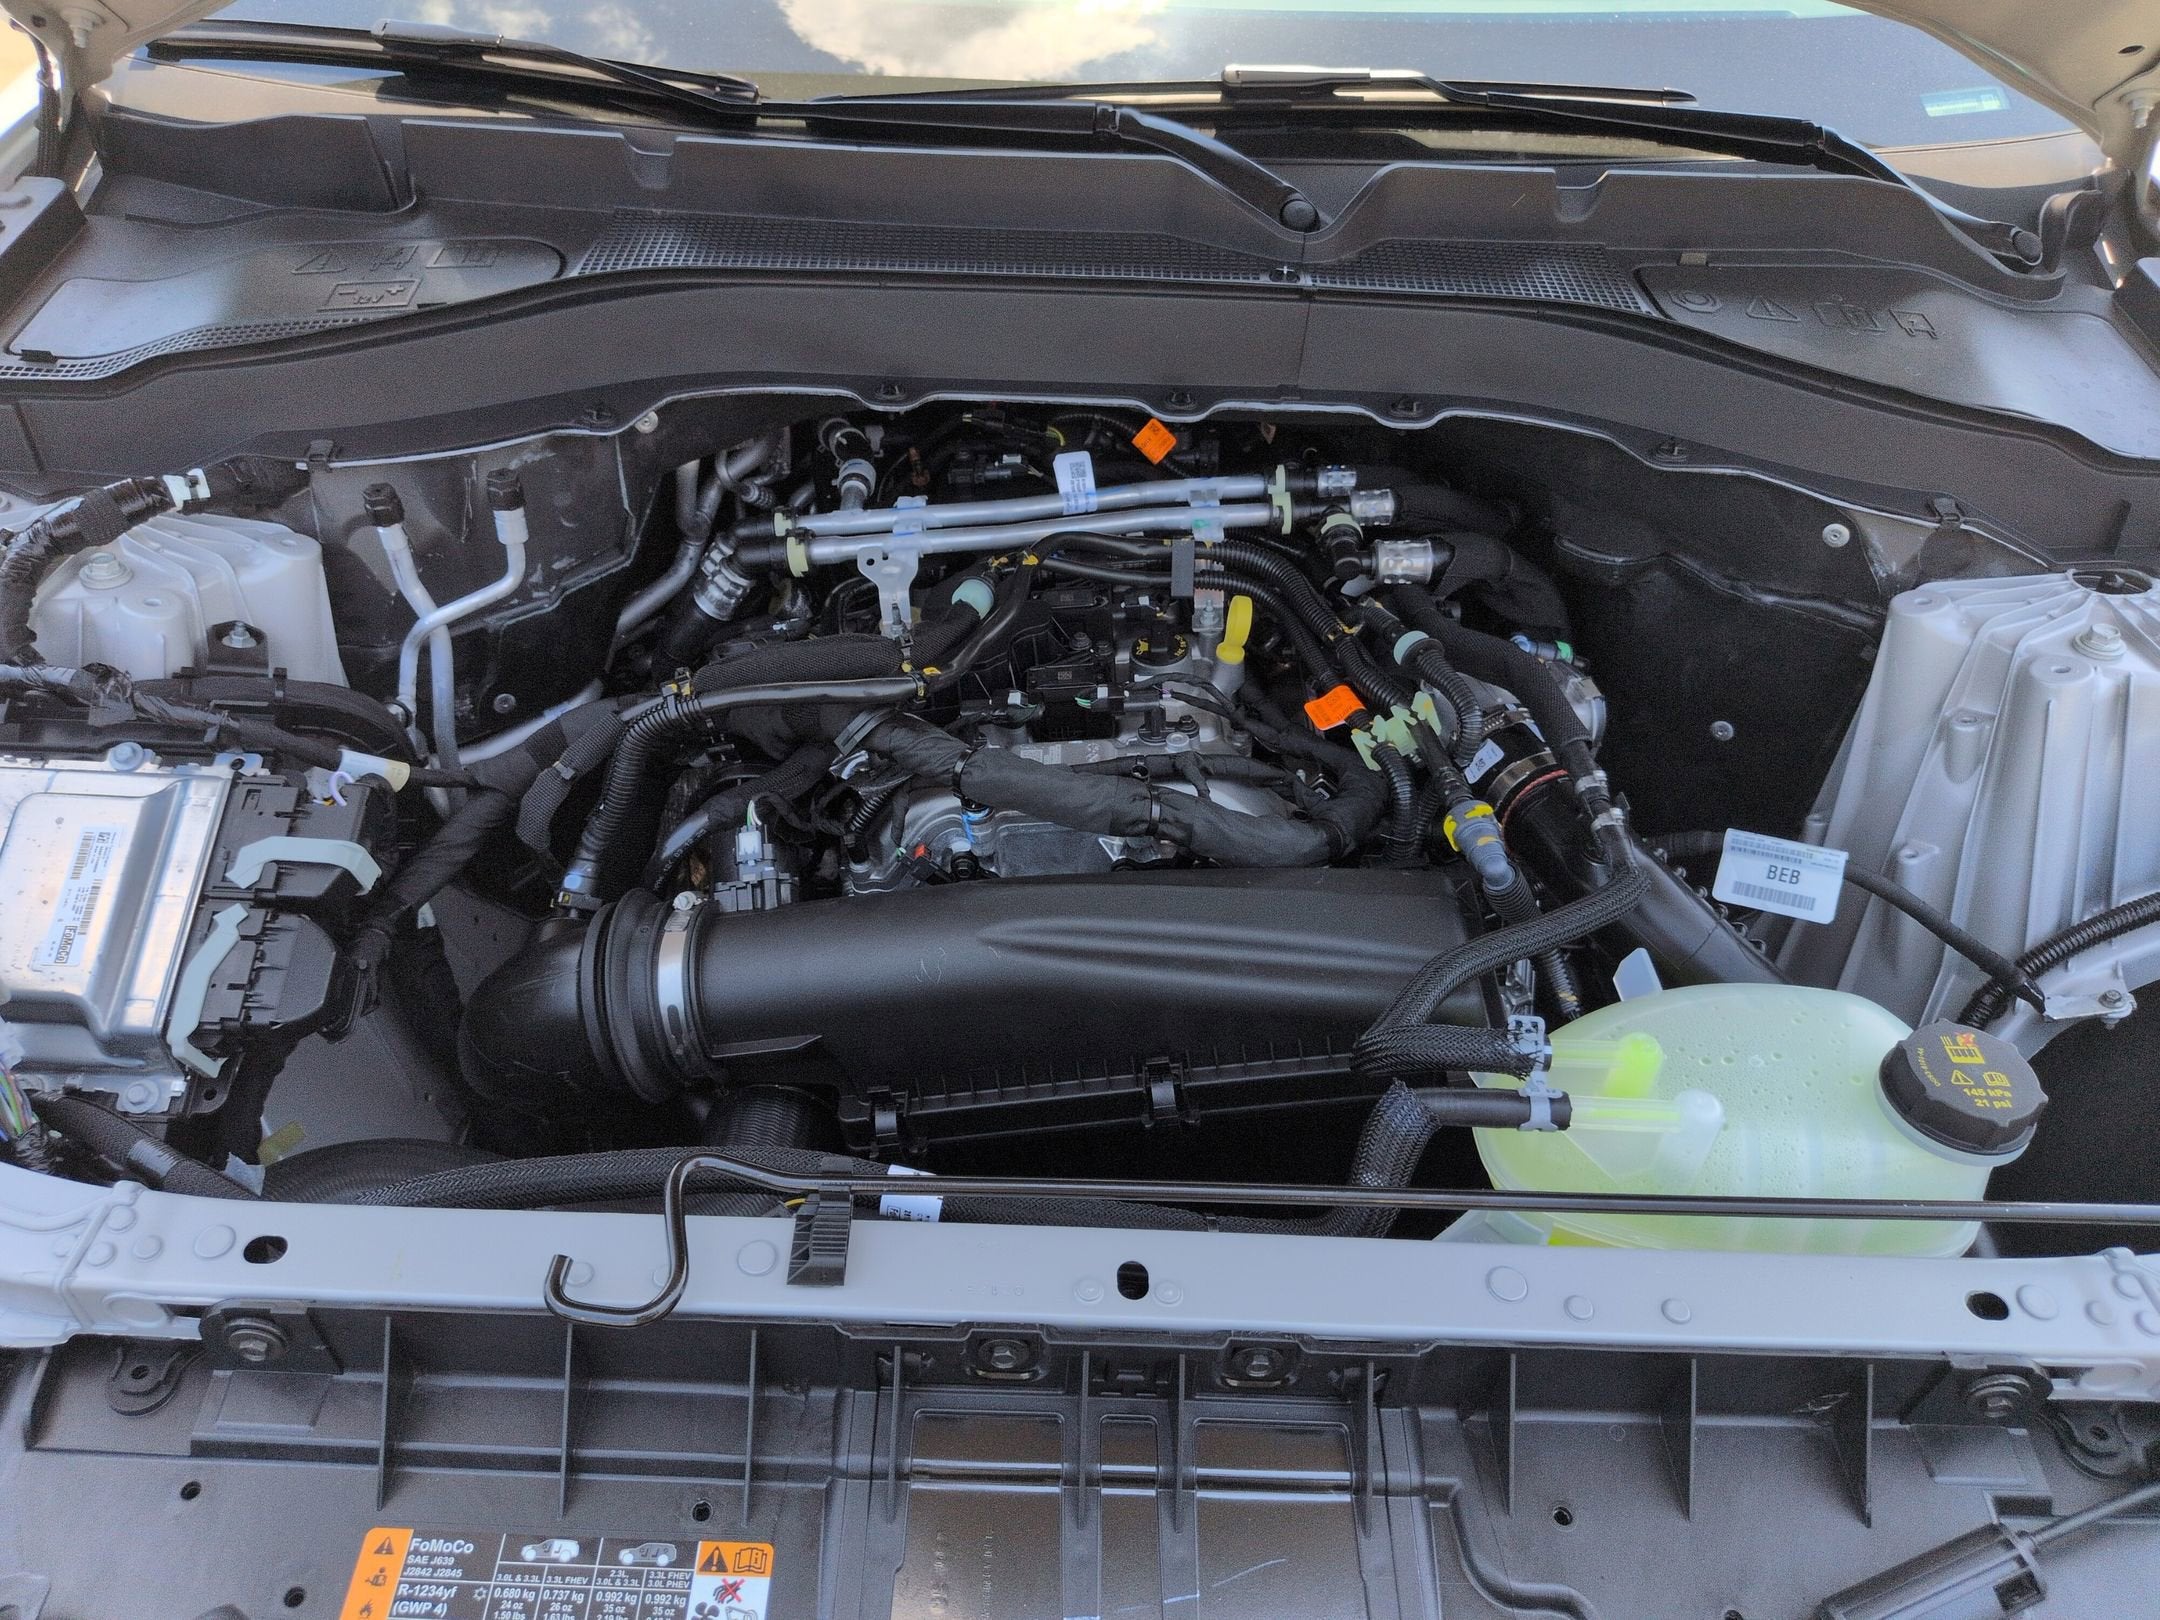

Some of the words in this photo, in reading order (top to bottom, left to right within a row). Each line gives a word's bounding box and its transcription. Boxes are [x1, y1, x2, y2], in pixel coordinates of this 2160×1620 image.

[1766, 864, 1801, 885] BEB
[57, 927, 76, 962] FoMoCo
[1986, 1088, 2012, 1098] kPa
[1974, 1098, 1990, 1107] 21
[1992, 1099, 2013, 1110] psi
[410, 1537, 474, 1554] FoMoCo
[407, 1554, 429, 1565] SAE
[430, 1555, 455, 1566] J639
[403, 1566, 432, 1577] J2842
[433, 1567, 463, 1578] J2845
[514, 1573, 522, 1582] &
[649, 1571, 666, 1580] 3.3L
[667, 1571, 692, 1581] FHEV
[546, 1575, 563, 1584] 3.3L
[565, 1576, 589, 1585] FHEV
[614, 1578, 621, 1586] &
[647, 1580, 664, 1588] 3.0L
[666, 1581, 690, 1589] PHEV
[396, 1583, 459, 1600] R-1234yf
[494, 1587, 521, 1599] 0.680
[522, 1588, 536, 1602] kg
[543, 1589, 570, 1601] 0.737
[571, 1590, 585, 1604] kg
[596, 1590, 623, 1602] 0.992
[624, 1592, 638, 1605] kg
[500, 1600, 512, 1610] 24
[513, 1602, 524, 1610] oz
[645, 1593, 672, 1605] 0.992
[673, 1594, 687, 1607] kg
[391, 1600, 432, 1616] (GWP
[433, 1602, 448, 1618] 4)
[549, 1602, 561, 1612] 26
[562, 1604, 574, 1612] oz
[603, 1603, 614, 1613] 35
[615, 1605, 627, 1613] oz
[652, 1606, 664, 1615] 35
[664, 1608, 676, 1616] oz
[512, 1611, 526, 1620] lbs
